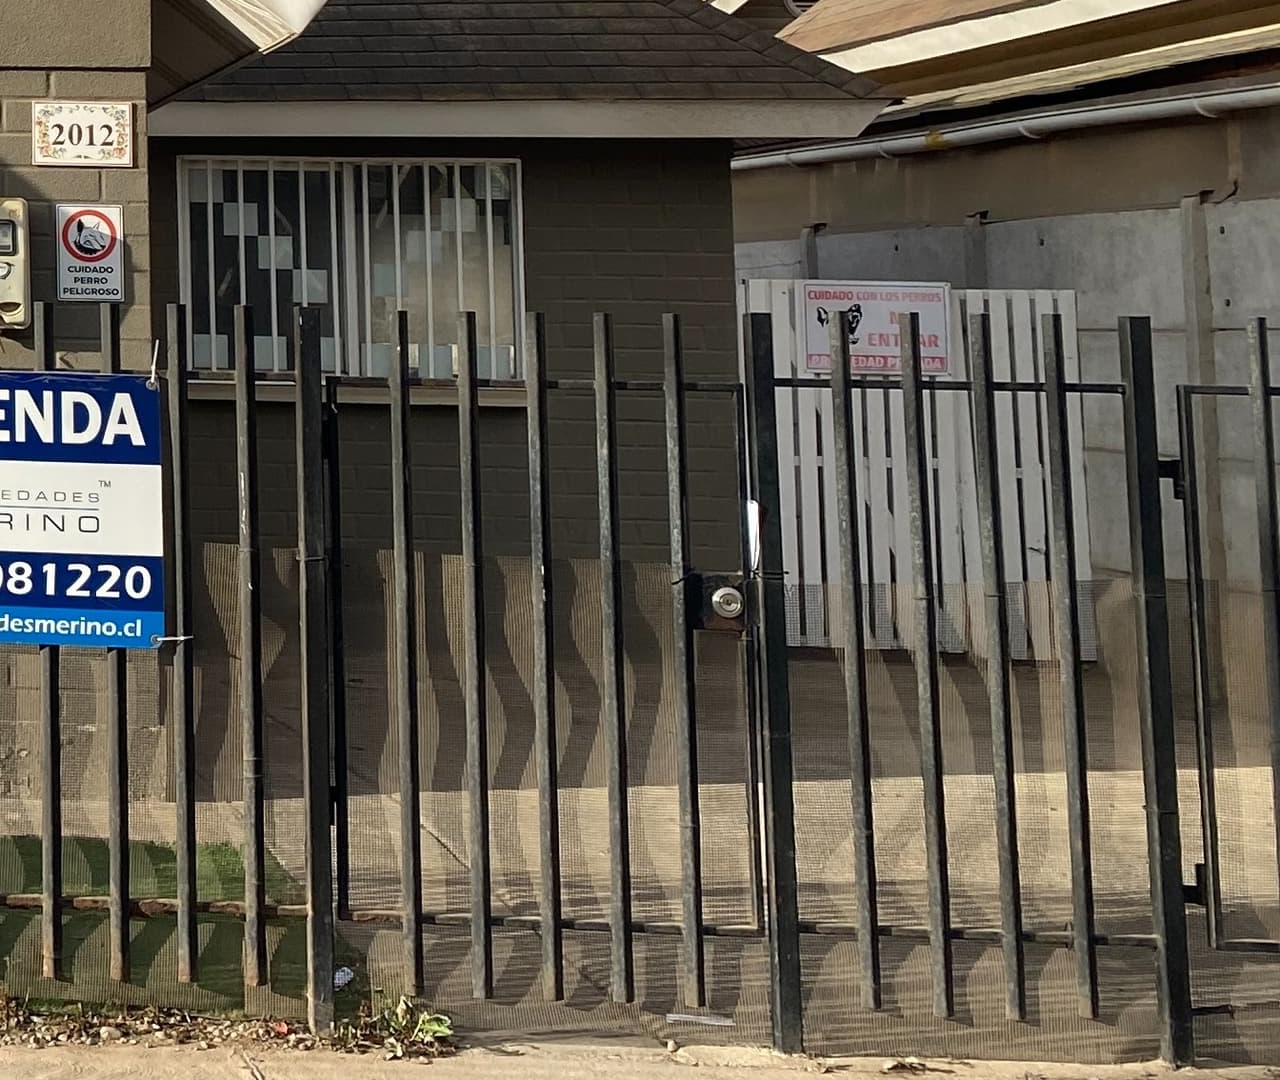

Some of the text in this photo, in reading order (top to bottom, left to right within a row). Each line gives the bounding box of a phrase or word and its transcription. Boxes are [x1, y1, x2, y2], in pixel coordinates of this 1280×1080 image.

[51, 123, 115, 147] 2012
[67, 265, 114, 275] CUIDADO
[74, 276, 108, 285] PERRO
[63, 287, 120, 296] PELIGROSO
[808, 290, 854, 300] CUIDADO
[857, 291, 878, 301] CON
[880, 292, 899, 301] LOS
[868, 333, 939, 347] ENTAR
[811, 355, 884, 368] PREDAD
